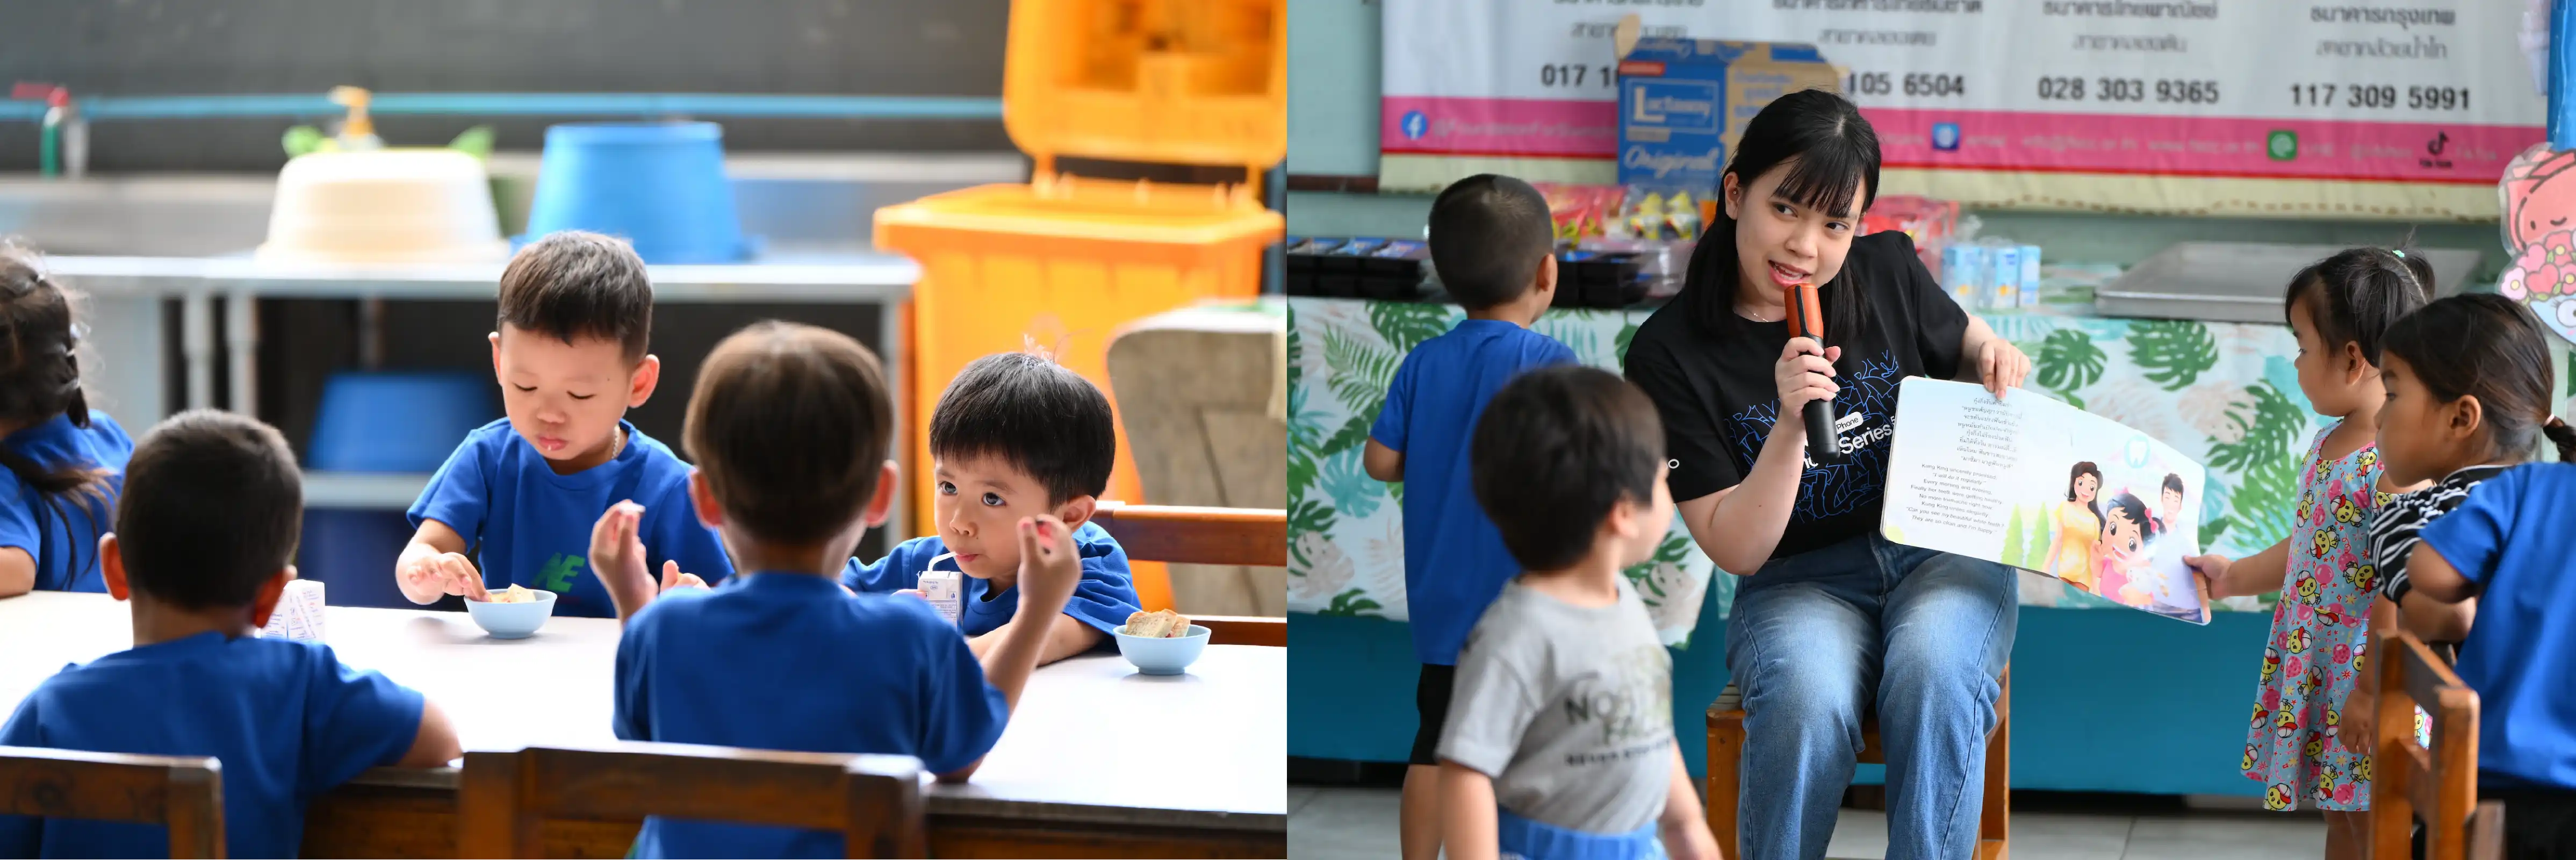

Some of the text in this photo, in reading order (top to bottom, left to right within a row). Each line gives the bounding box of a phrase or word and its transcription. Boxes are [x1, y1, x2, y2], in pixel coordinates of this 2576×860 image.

[2310, 6, 2456, 31] ธนาคารกรุงเทพ
[1541, 64, 1587, 87] 017
[1849, 71, 1965, 96] 105 6504
[2038, 76, 2220, 104] 028 303 9365
[2290, 83, 2470, 111] 117 309 5991
[1624, 145, 1719, 179] Original
[1838, 424, 1893, 454] Series
